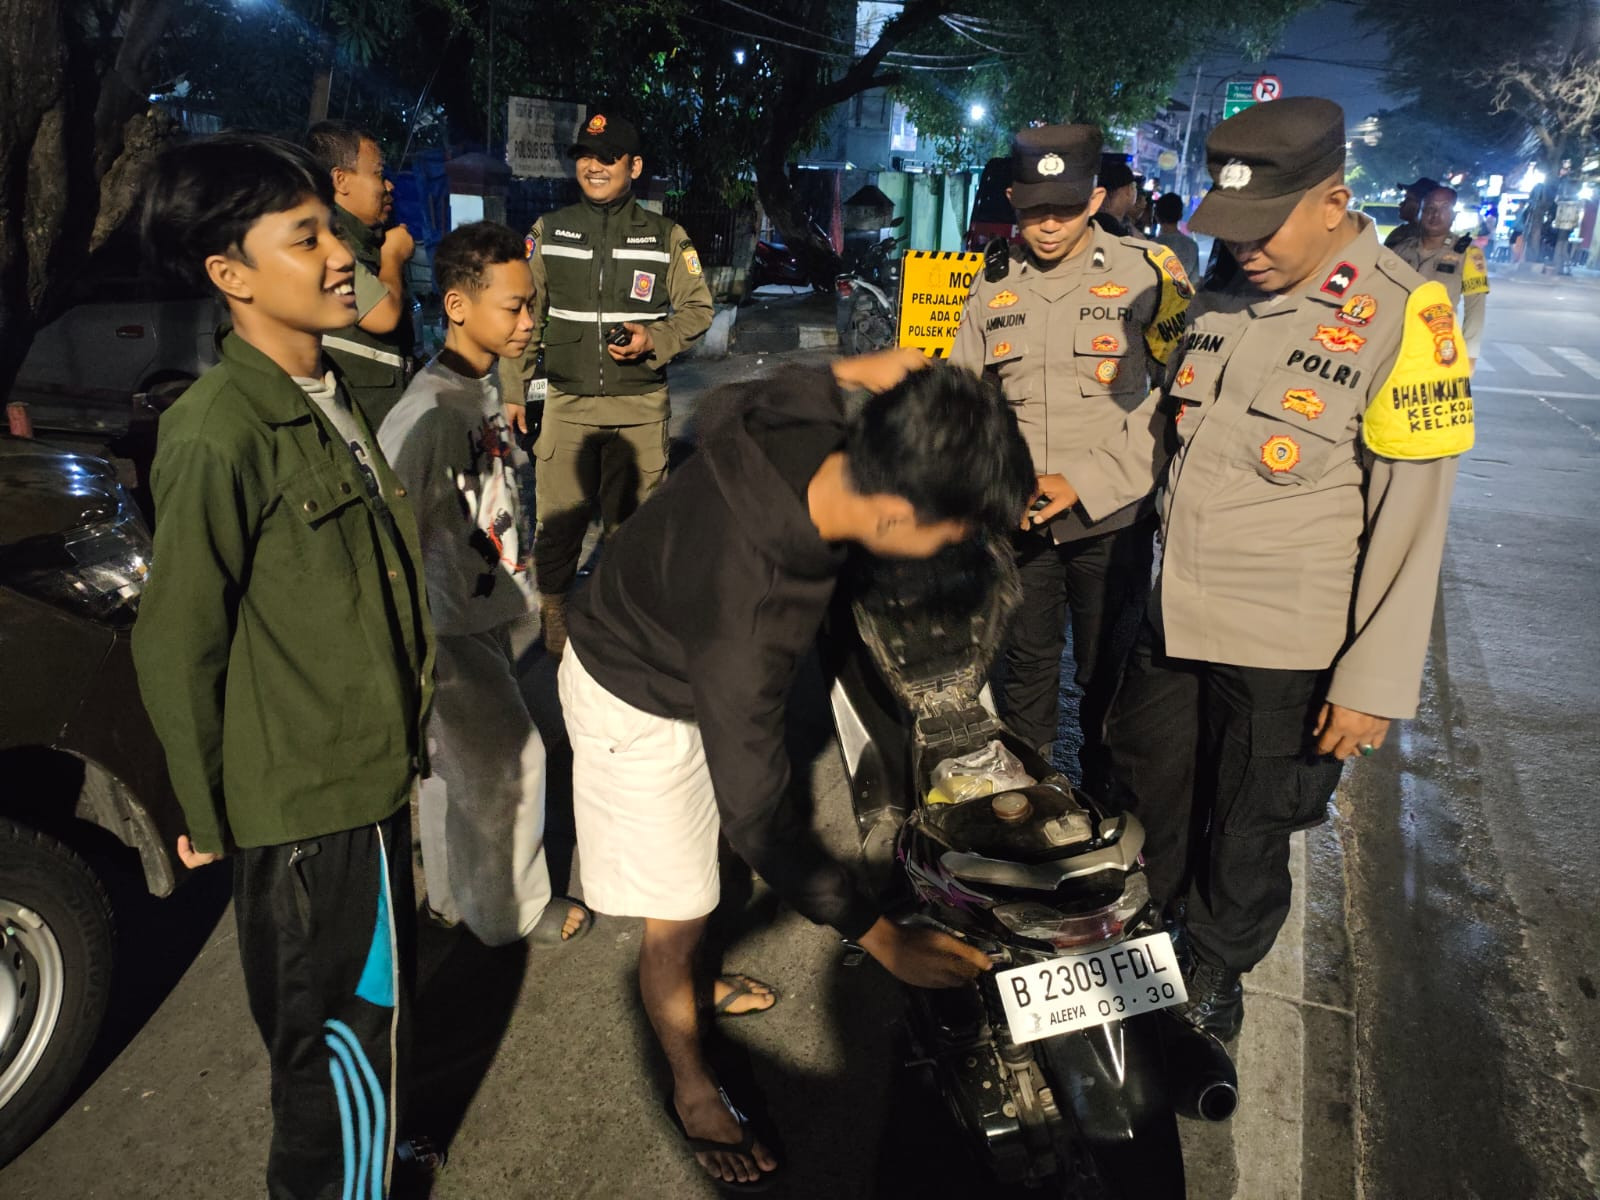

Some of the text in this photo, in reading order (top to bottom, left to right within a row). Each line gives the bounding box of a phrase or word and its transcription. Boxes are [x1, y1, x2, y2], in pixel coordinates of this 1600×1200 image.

[555, 229, 582, 240] DADAN
[930, 311, 950, 322] ADA
[1080, 307, 1133, 321] POLRI
[985, 313, 1026, 332] AMINUDIN
[908, 326, 943, 338] POLSEK
[1287, 350, 1361, 389] POLRI
[1011, 943, 1167, 1008] B 2309 FDL
[1050, 1004, 1087, 1025] ALEEYA
